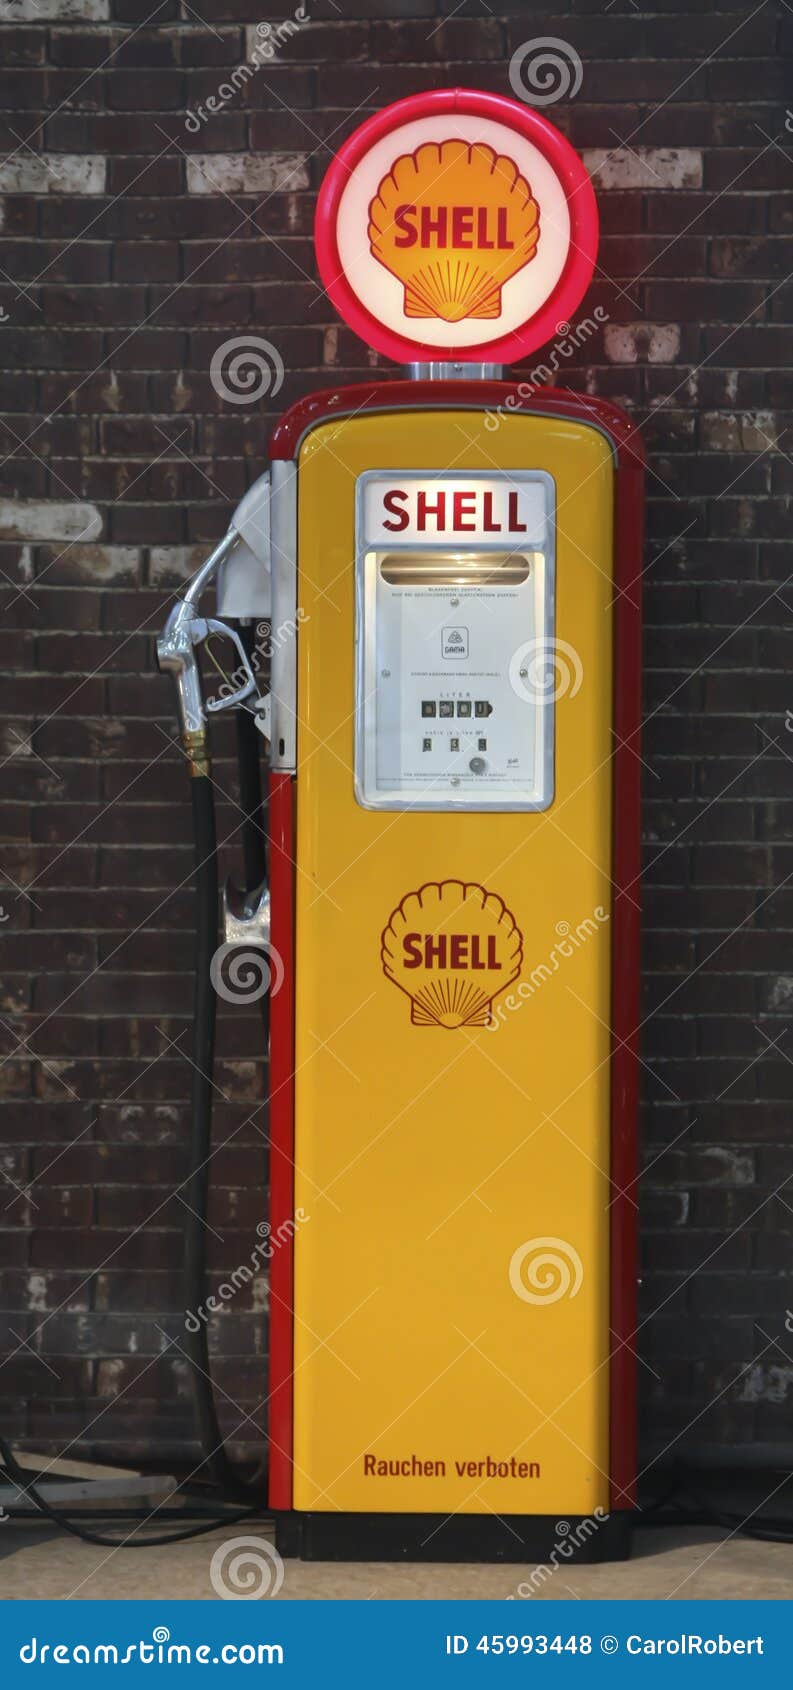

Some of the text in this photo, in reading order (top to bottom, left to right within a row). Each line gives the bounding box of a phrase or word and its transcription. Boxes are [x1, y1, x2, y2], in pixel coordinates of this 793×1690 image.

[394, 204, 514, 250] SHELL
[382, 490, 527, 532] SHELL
[403, 933, 502, 970] SHELL
[364, 1454, 541, 1479] Rauchen verboten
